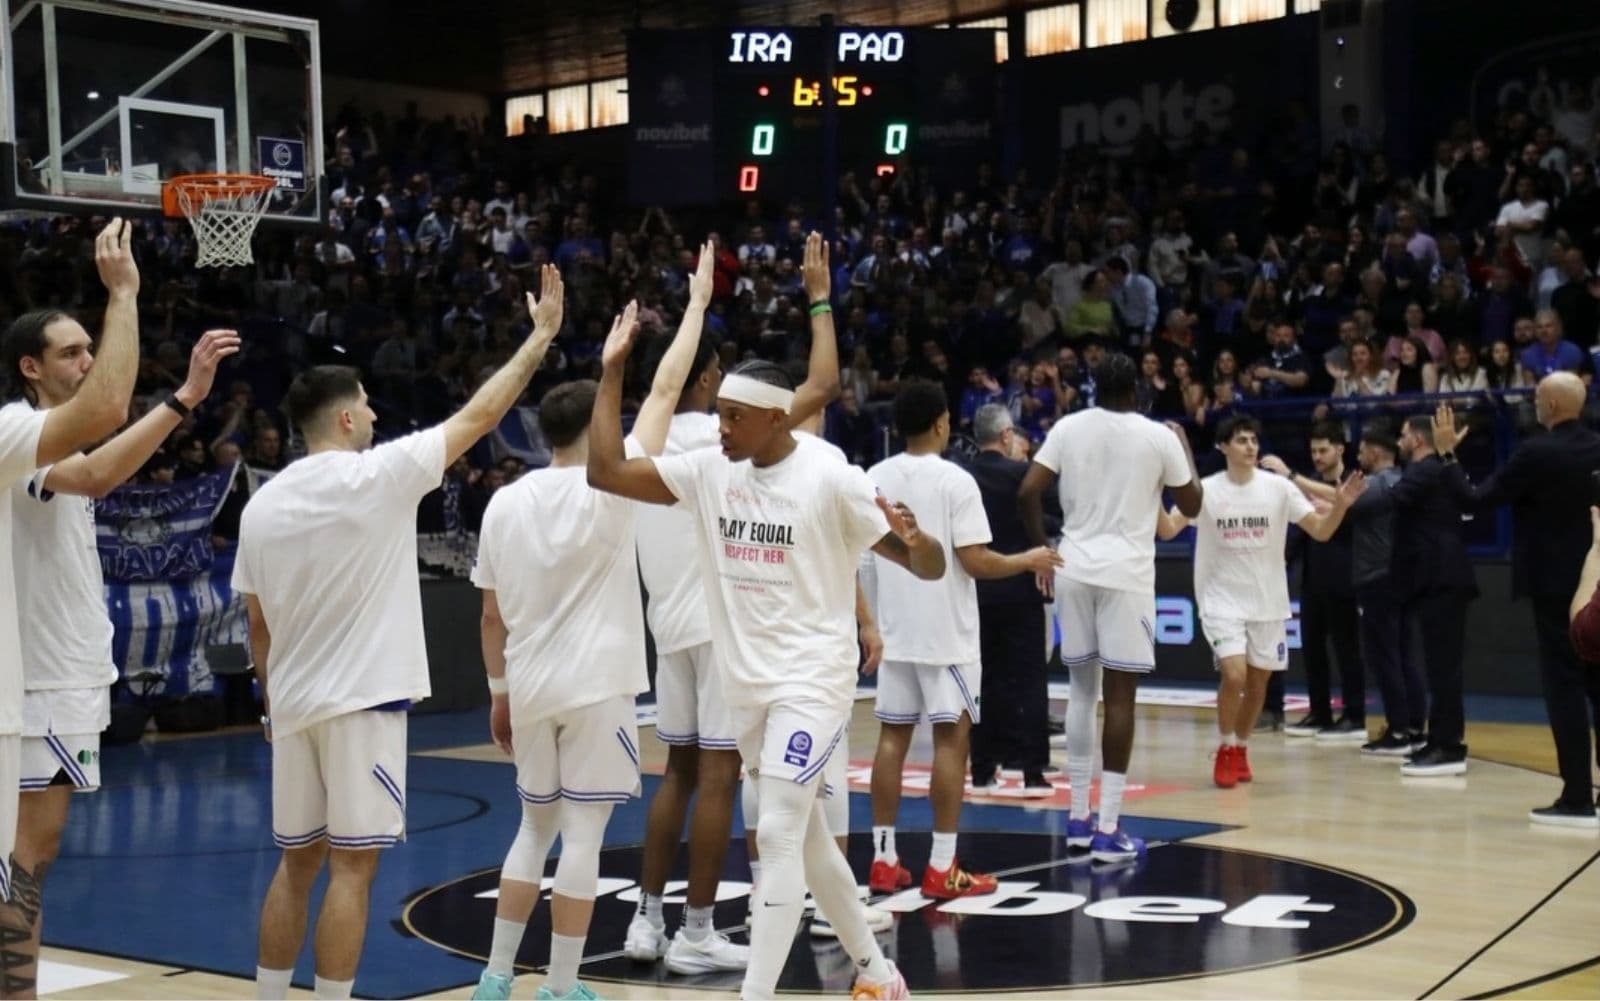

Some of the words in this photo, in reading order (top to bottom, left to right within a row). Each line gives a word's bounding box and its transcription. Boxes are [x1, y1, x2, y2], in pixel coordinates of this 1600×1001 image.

[729, 32, 793, 63] IRA
[838, 32, 904, 63] PAO
[1059, 78, 1235, 150] nolte
[636, 121, 710, 141] novibet
[752, 125, 775, 155] 0
[885, 124, 908, 155] 0
[739, 166, 759, 192] 0
[718, 516, 747, 540] PLAY
[750, 522, 795, 545] EQUAL
[1216, 517, 1239, 529] PLAY
[763, 549, 784, 564] HER
